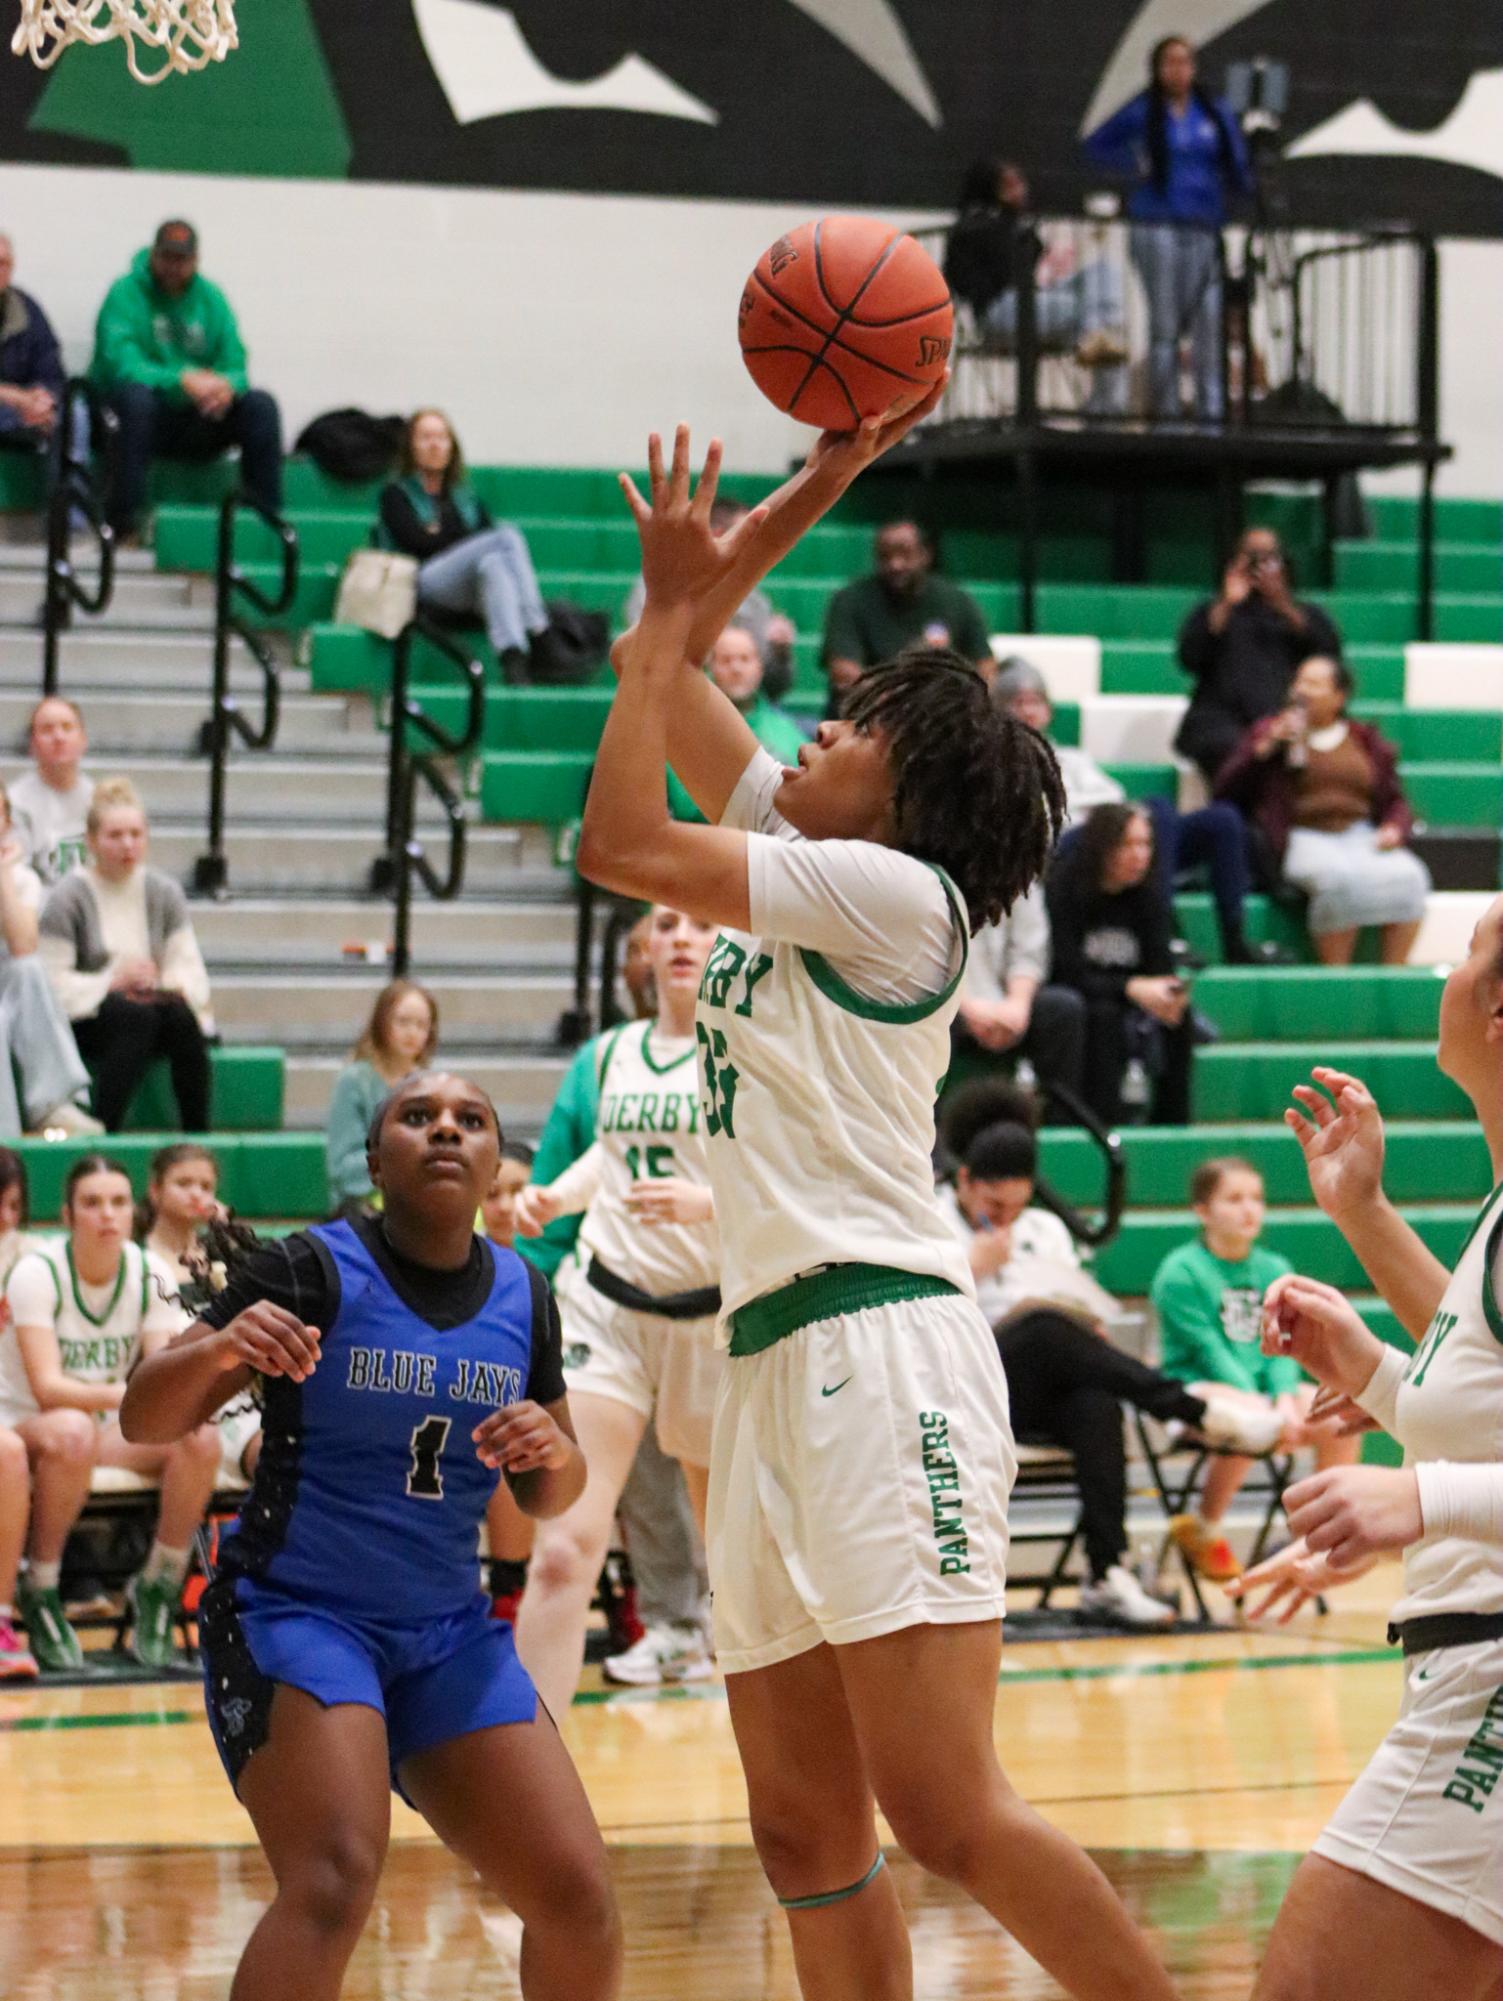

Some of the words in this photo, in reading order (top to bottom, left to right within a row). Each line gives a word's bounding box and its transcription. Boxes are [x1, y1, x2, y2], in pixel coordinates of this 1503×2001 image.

[347, 1347, 437, 1397] BLUE
[450, 1358, 521, 1407] JAYS
[406, 1414, 452, 1500] 1
[919, 1411, 971, 1576] PANTHERS
